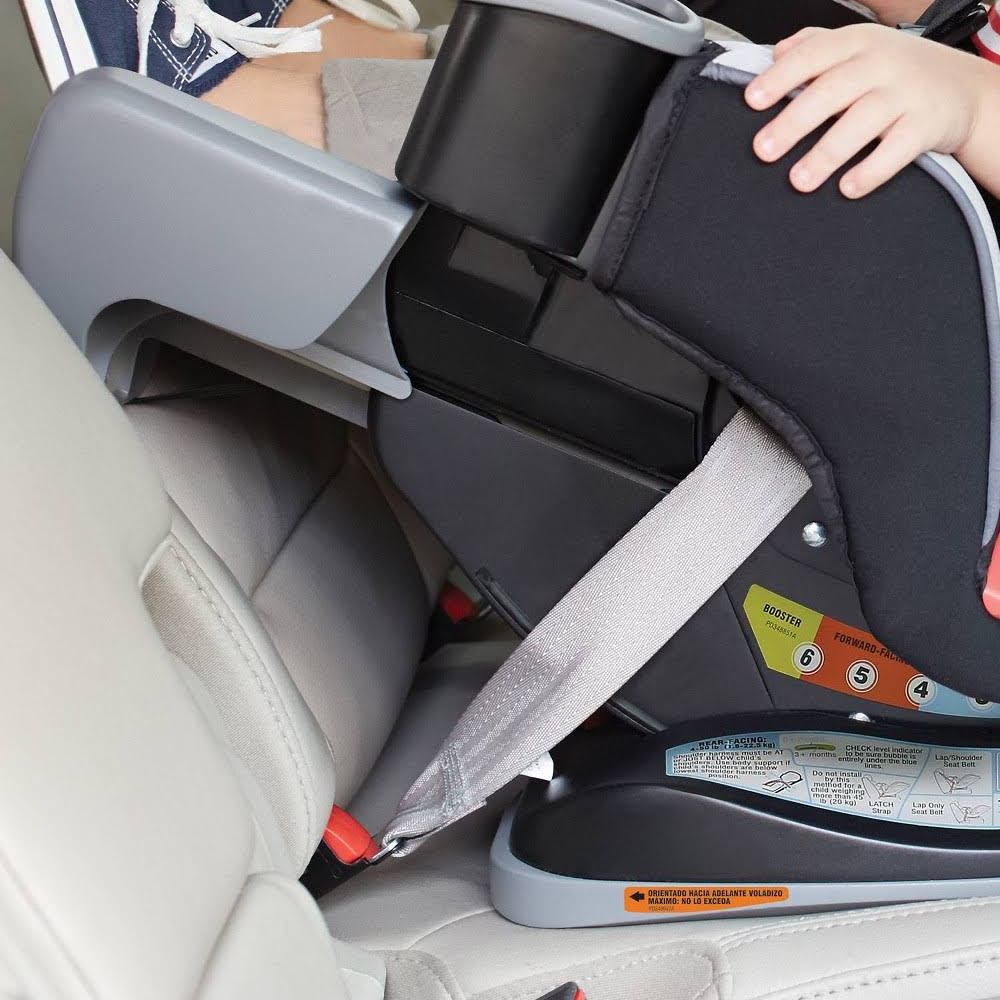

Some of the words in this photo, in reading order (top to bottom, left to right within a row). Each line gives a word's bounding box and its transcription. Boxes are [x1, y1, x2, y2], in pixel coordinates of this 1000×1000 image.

[763, 604, 802, 627] BOOSTER
[800, 648, 814, 666] 6
[854, 666, 870, 684] 5
[914, 681, 928, 698] 4
